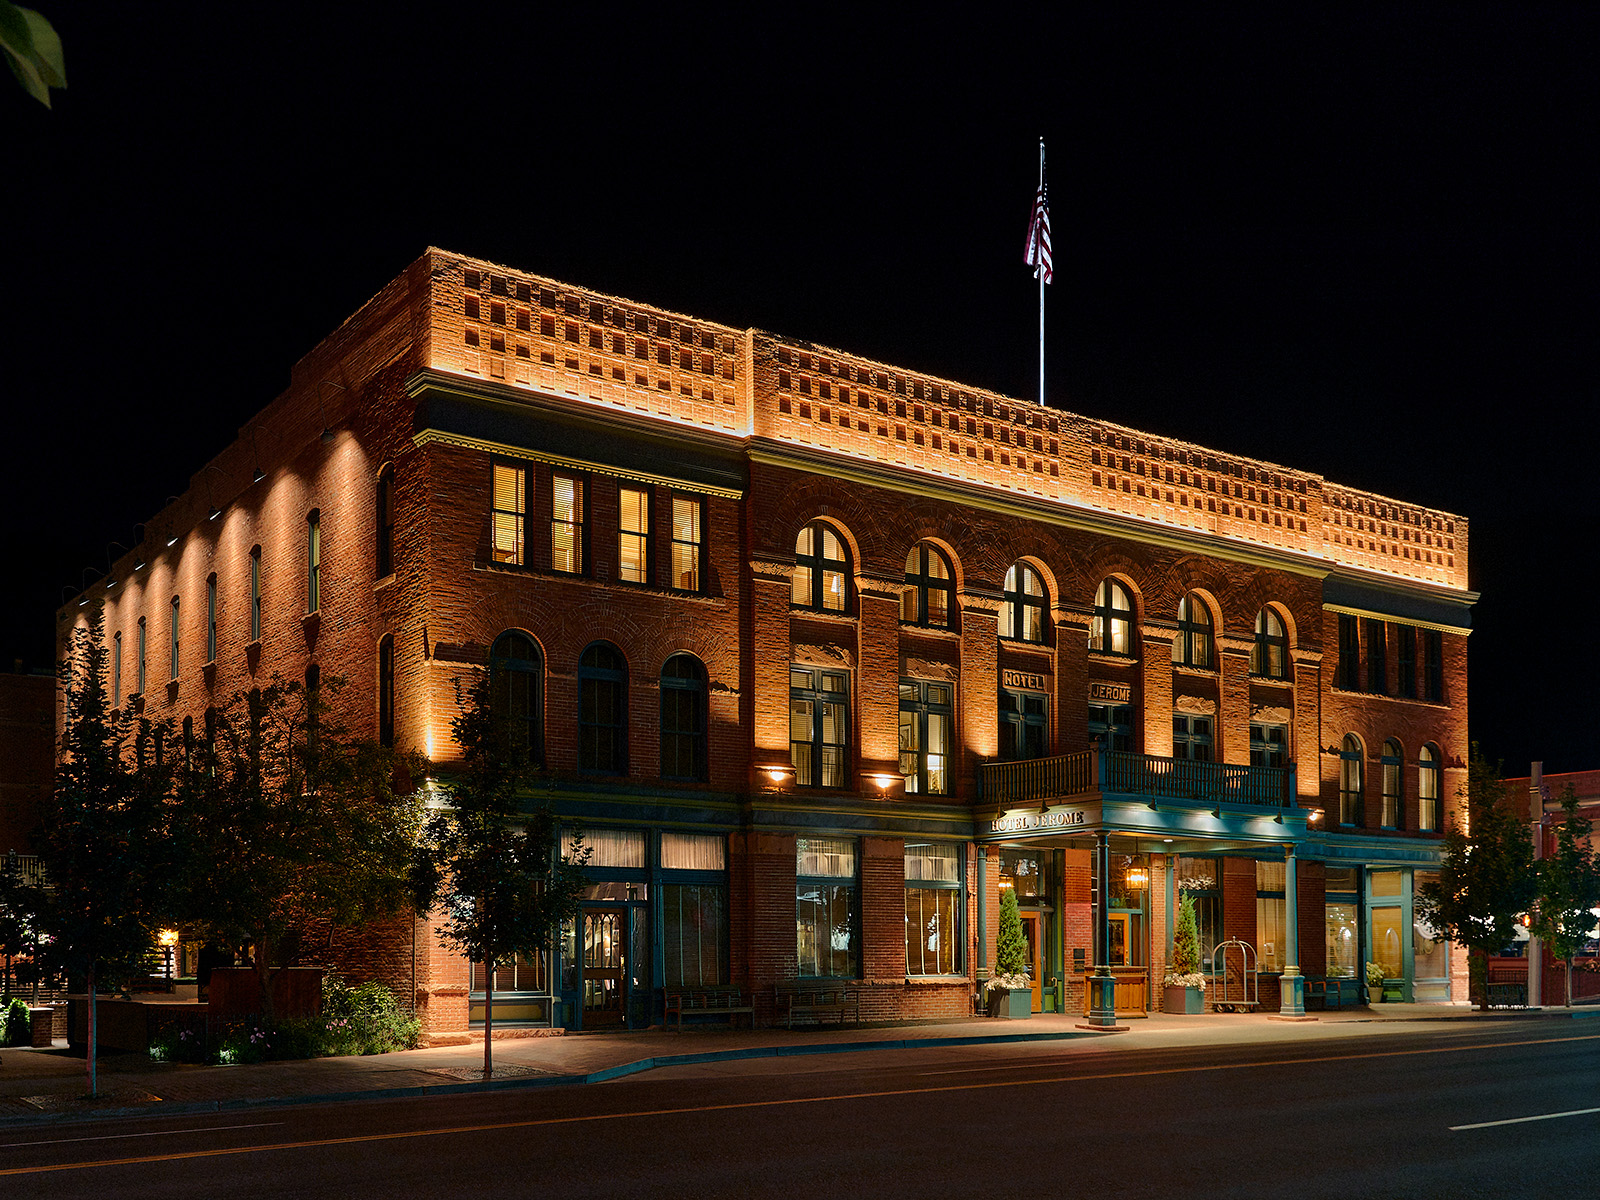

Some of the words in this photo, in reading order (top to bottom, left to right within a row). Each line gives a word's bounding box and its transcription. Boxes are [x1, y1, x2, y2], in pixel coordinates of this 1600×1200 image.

[1004, 672, 1043, 690] HOTEL
[1093, 686, 1131, 702] JEROME
[991, 817, 1029, 832] HOTEL
[1032, 811, 1084, 827] JEROME
